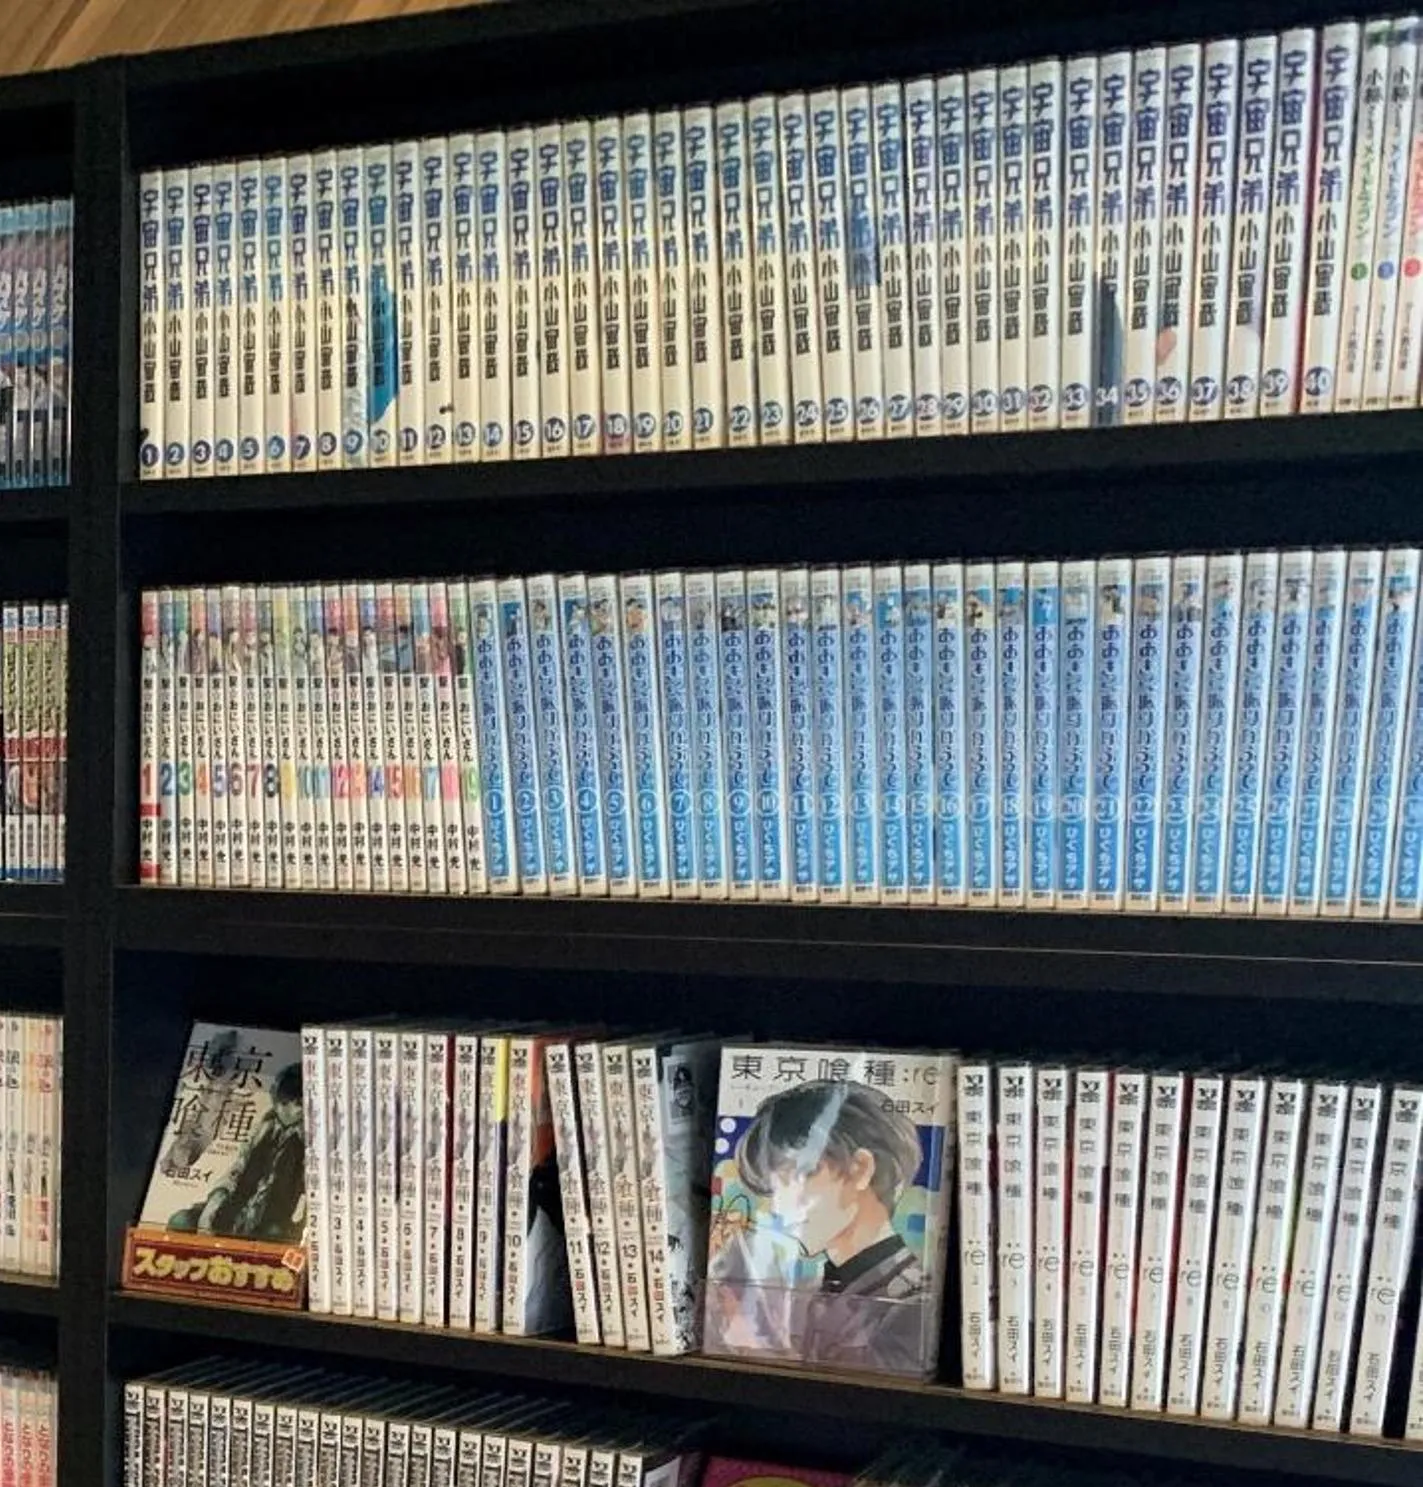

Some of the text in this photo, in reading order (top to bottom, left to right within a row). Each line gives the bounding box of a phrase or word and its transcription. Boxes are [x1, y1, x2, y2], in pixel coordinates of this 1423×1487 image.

[1203, 61, 1231, 215] 宇宙兄弟
[1245, 60, 1272, 213] 宇宙兄弟
[1280, 50, 1307, 207] 宇宙兄弟
[1321, 44, 1350, 201] 宇宙兄弟
[1002, 88, 1024, 231] 宇宙兄弟
[1069, 78, 1092, 227] 宇宙兄弟
[1135, 69, 1160, 218] 宇宙兄弟
[684, 124, 707, 262] 宇宙兄弟
[783, 112, 804, 250] 宇宙兄弟
[511, 147, 530, 278] 宇宙兄弟
[540, 143, 560, 277] 宇宙兄弟
[598, 136, 619, 271] 宇宙兄弟
[317, 169, 333, 297] 宇宙兄弟
[396, 161, 414, 290] 宇宙兄弟
[142, 188, 159, 312] 宇宙兄弟
[193, 182, 210, 310] 宇宙兄弟
[909, 99, 938, 421] 宇宙兄弟 28
[1095, 383, 1118, 409] 34
[1127, 379, 1150, 406] 35
[1193, 376, 1217, 404] 37
[1264, 368, 1289, 396] 39
[1306, 367, 1332, 395] 40
[545, 417, 565, 442] 16
[607, 414, 627, 438] 18
[141, 444, 158, 465] 1
[160, 763, 173, 795] 2
[177, 762, 191, 795] 3
[228, 764, 242, 798] 6
[263, 763, 277, 797] 8
[387, 765, 402, 799] 15
[182, 1040, 273, 1094] 東京
[309, 1213, 318, 1225] 2
[334, 1216, 342, 1228] 3
[430, 1226, 439, 1239] 7
[507, 1234, 522, 1248] 10
[568, 1240, 584, 1255] 11
[622, 1244, 637, 1259] 13
[649, 1248, 665, 1263] 14
[134, 1248, 296, 1293] スタッフおすすめ
